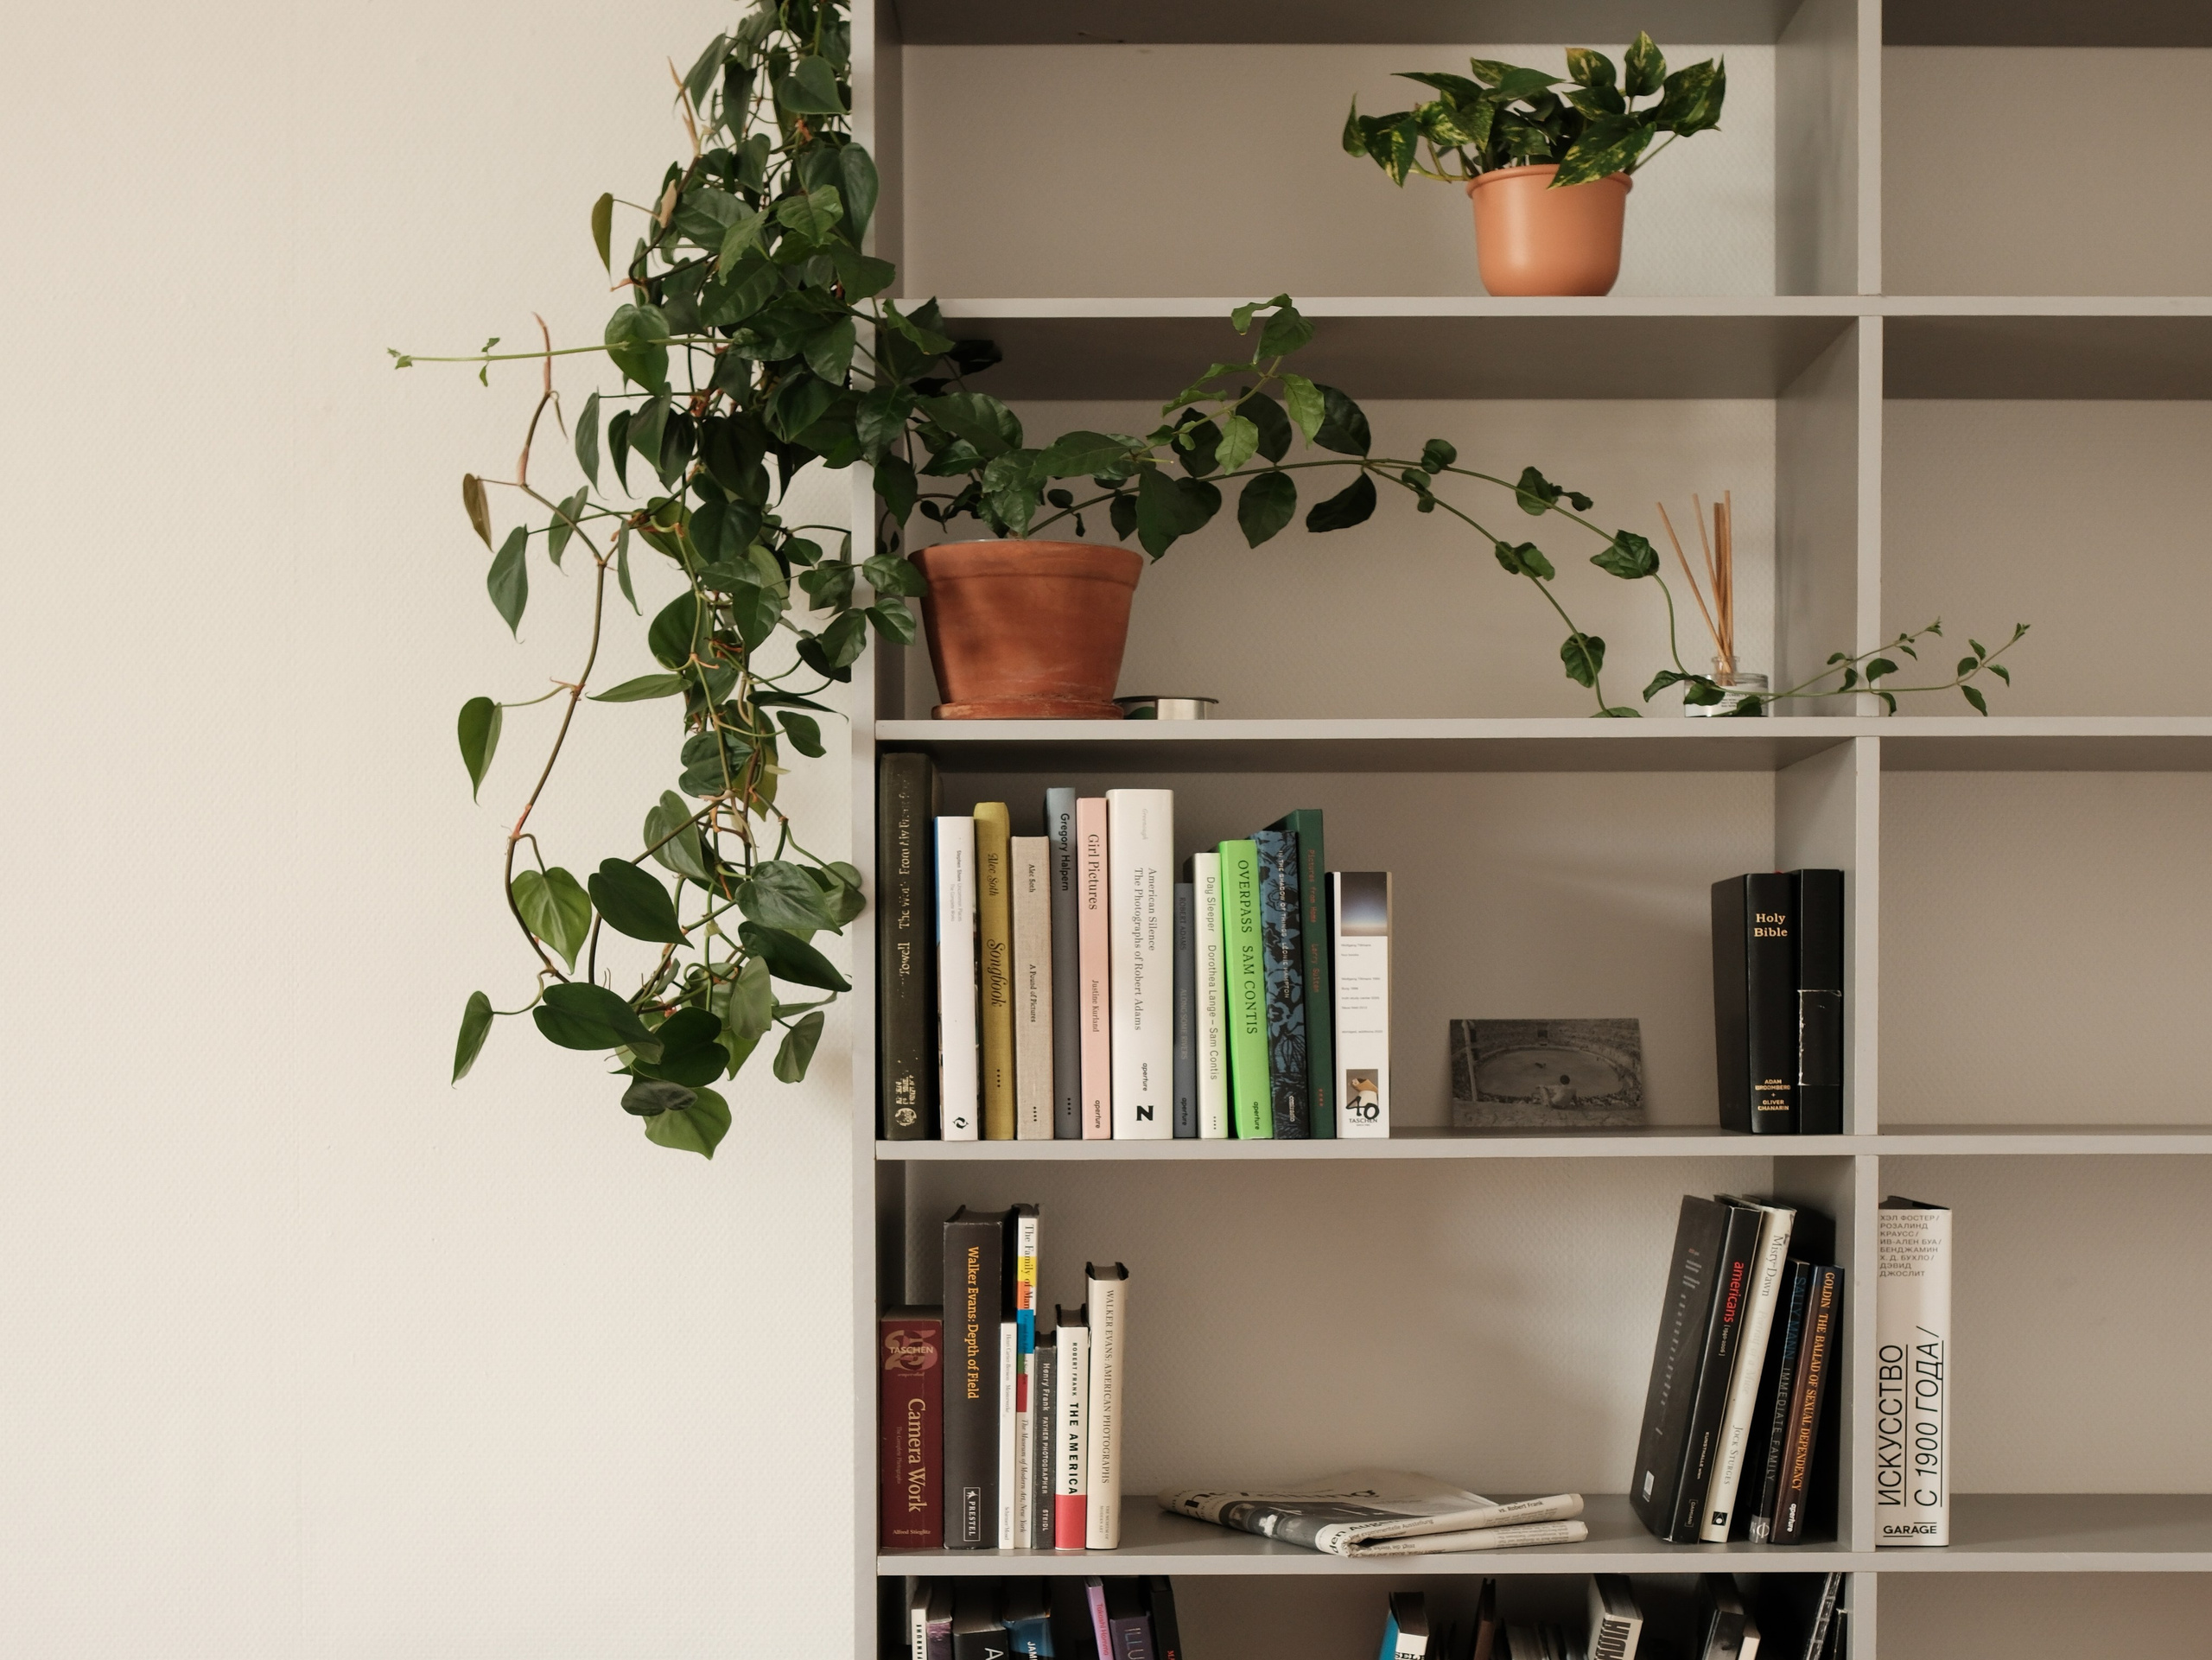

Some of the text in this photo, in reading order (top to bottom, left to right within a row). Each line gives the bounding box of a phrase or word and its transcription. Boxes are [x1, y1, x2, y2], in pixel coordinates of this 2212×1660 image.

[1059, 813, 1071, 892] Gregory Halpern
[1088, 834, 1100, 911] Girl Pictures
[988, 854, 999, 897] Alec Soth
[1147, 868, 1158, 951] American Silence
[1179, 897, 1187, 925] ROBERT
[1205, 876, 1216, 932] Day Sleeper
[1756, 913, 1786, 925] Holy
[1131, 868, 1144, 1031] The Photographs of Robert Adams
[1237, 860, 1258, 1034] OVERPASS SAM CONTIS
[1754, 927, 1789, 938] Bible
[987, 939, 1007, 1008] Songbook
[1179, 989, 1188, 1013] ALONG
[1207, 945, 1220, 1080] Dorothea Lange Sam Contis
[1180, 1036, 1189, 1060] RIVERS
[1141, 1063, 1149, 1091] aperture
[1093, 1100, 1102, 1129] aperture
[1180, 1097, 1189, 1126] aperture
[1253, 1102, 1262, 1130] aperture
[1020, 1224, 1034, 1309] The Family of Man
[1724, 1262, 1745, 1323] americans
[1821, 1271, 1834, 1308] GOLDIN
[964, 1247, 979, 1399] Walker Evans: Depth of Field
[1042, 1389, 1051, 1411] Frank
[1101, 1290, 1115, 1484] WALKER EVANS: AMERICAN PHOTOGRAPHS
[1791, 1313, 1829, 1491] THE BALLAD OF SEXUAL DEPENDENCY
[907, 1398, 926, 1465] Camera
[1020, 1419, 1029, 1432] The
[1020, 1433, 1029, 1458] Museum
[1767, 1367, 1791, 1482] IMMEDIATE FAMILY
[1878, 1345, 1904, 1506] ИСКУССТВО
[1018, 1459, 1028, 1467] of
[1068, 1402, 1079, 1494] THE AMERICA
[1915, 1421, 1938, 1478] 1900
[907, 1466, 927, 1513] Work
[1019, 1491, 1028, 1503] Art,
[1020, 1467, 1028, 1490] Modern
[1786, 1503, 1797, 1532] aperture
[1883, 1525, 1937, 1534] GARAGE
[1027, 1641, 1038, 1660] JAM
[1096, 1603, 1109, 1656] Takashi Homma
